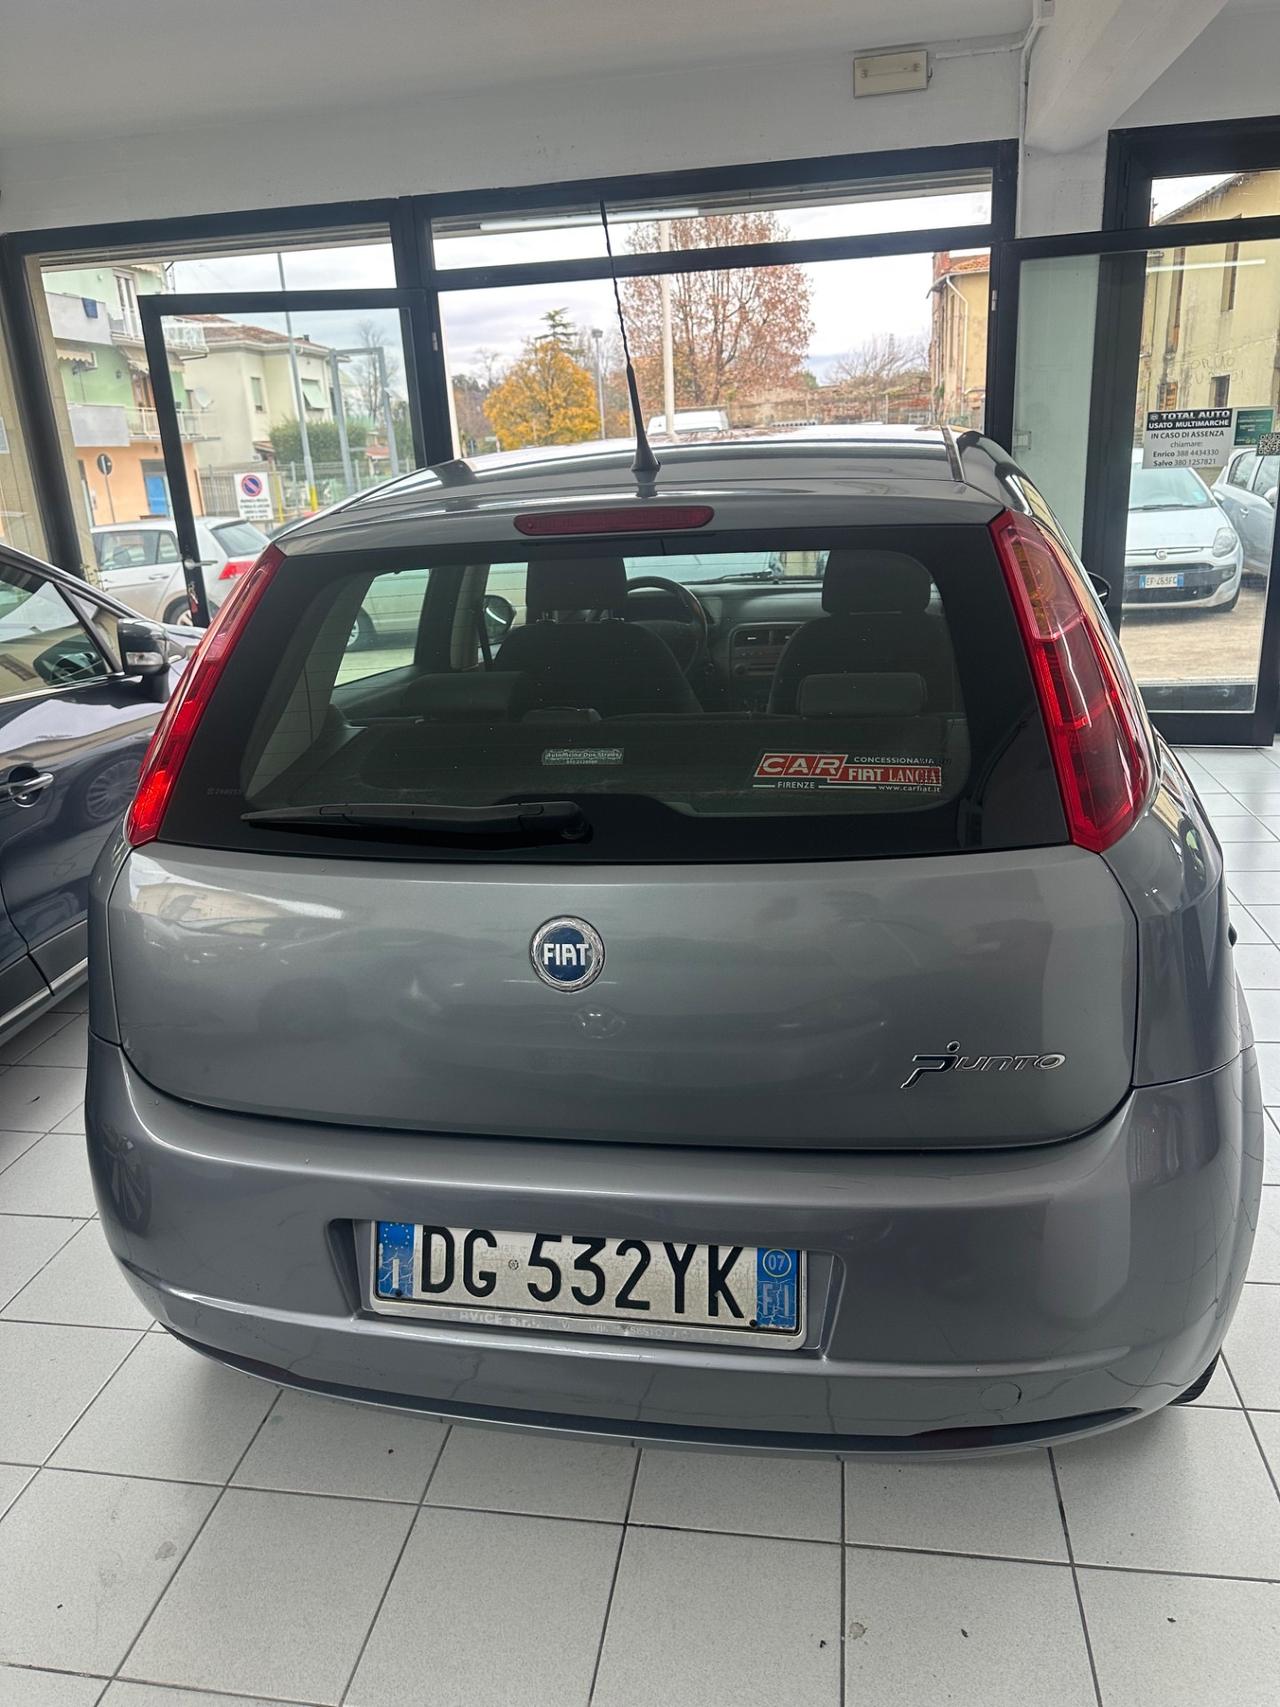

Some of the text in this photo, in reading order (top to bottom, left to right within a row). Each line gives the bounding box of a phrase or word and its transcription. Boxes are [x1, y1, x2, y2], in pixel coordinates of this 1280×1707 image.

[1161, 411, 1195, 420] TOTAL
[1198, 410, 1230, 419] AUTO
[1148, 421, 1173, 429] USATO
[1175, 419, 1229, 428] MULTIMARCHE
[1160, 431, 1180, 439] CASO
[1191, 430, 1224, 438] ASSENZA
[1153, 450, 1175, 458] Enrico
[762, 757, 840, 774] CAR
[849, 768, 937, 783] FIAT LANCIA
[777, 781, 815, 789] FIRENZE
[878, 784, 941, 793] www.carfiat.it
[543, 943, 589, 966] FIAT
[768, 1254, 786, 1271] 07
[421, 1226, 745, 1319] DG 532YK
[763, 1283, 789, 1317] FI
